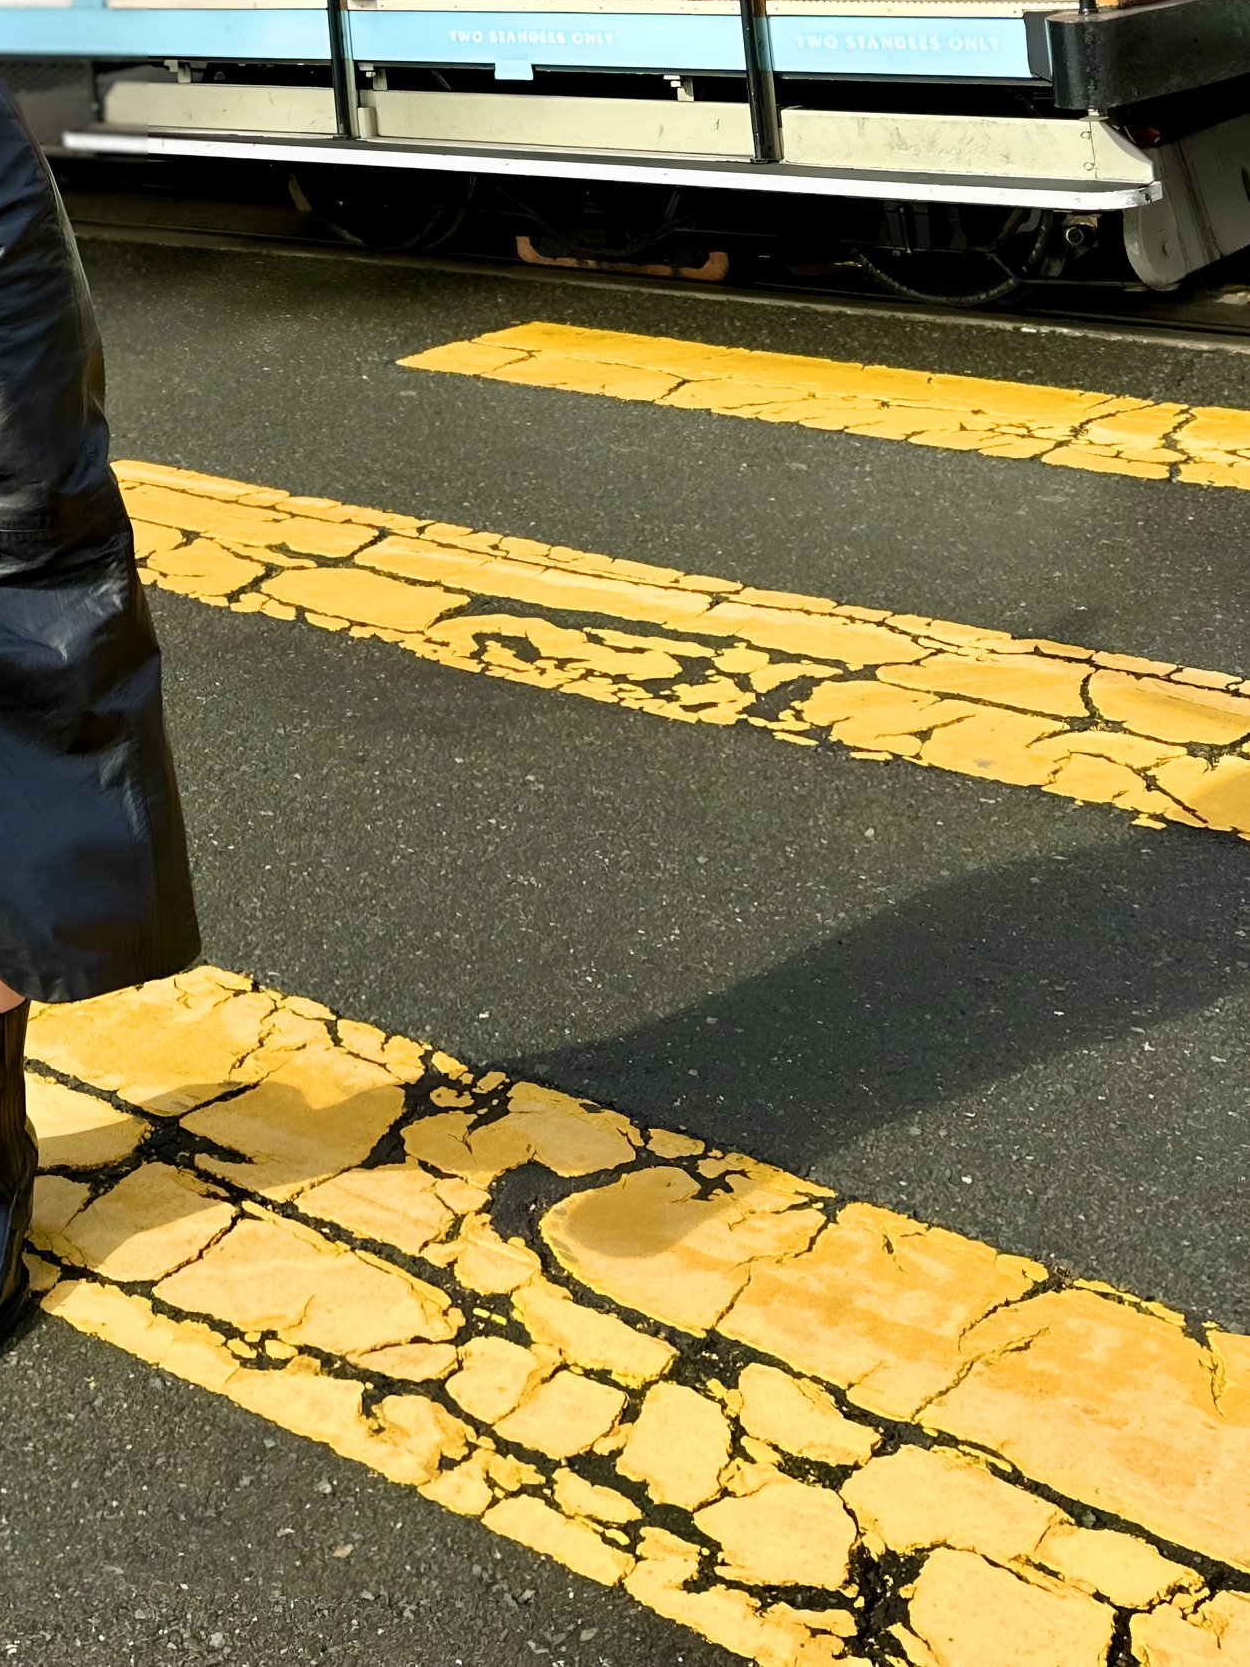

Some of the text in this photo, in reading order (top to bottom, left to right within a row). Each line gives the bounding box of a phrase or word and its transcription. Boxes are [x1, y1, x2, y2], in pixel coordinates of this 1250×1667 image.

[448, 30, 484, 44] TWO
[571, 31, 614, 46] ONLY
[796, 35, 839, 50] TWO
[947, 36, 1000, 52] ONLY
